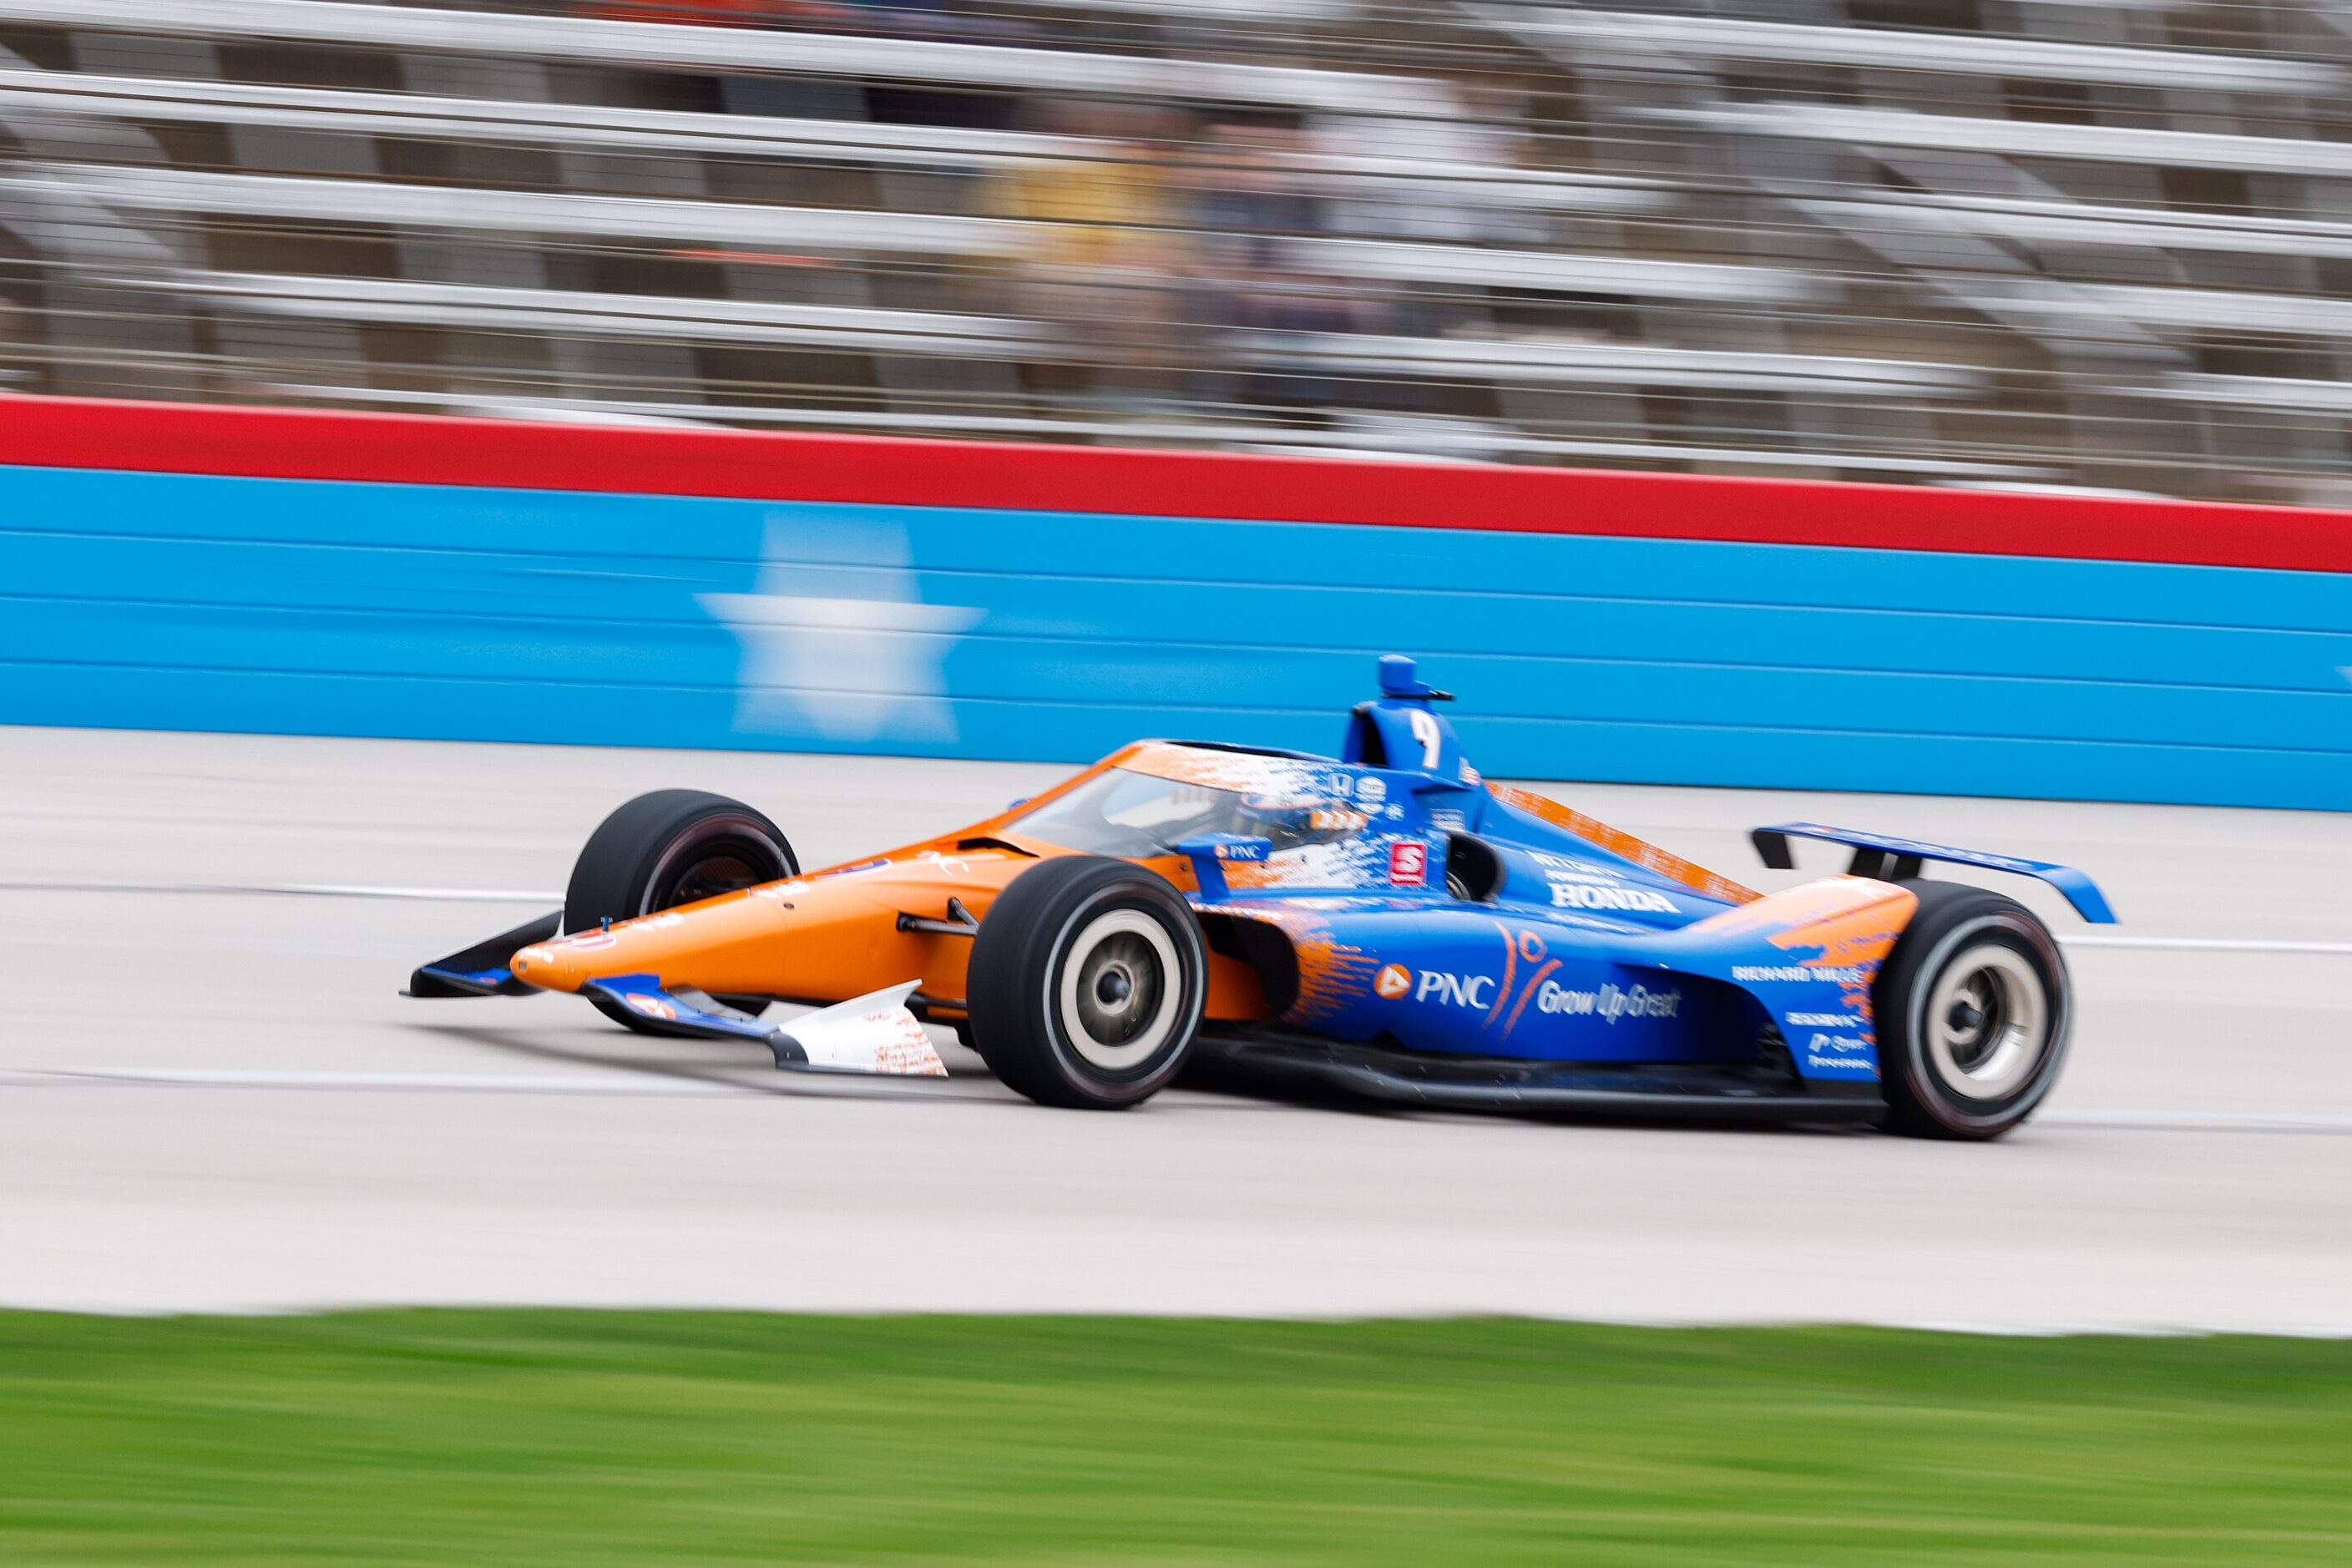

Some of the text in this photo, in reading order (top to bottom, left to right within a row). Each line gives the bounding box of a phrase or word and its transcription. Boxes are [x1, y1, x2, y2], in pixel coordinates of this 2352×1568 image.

[1410, 709, 1441, 770] 9
[1547, 883, 1682, 913] HONDA
[1415, 969, 1495, 1009] PNC
[1537, 979, 1598, 1015] Grow
[1596, 983, 1626, 1027] Up
